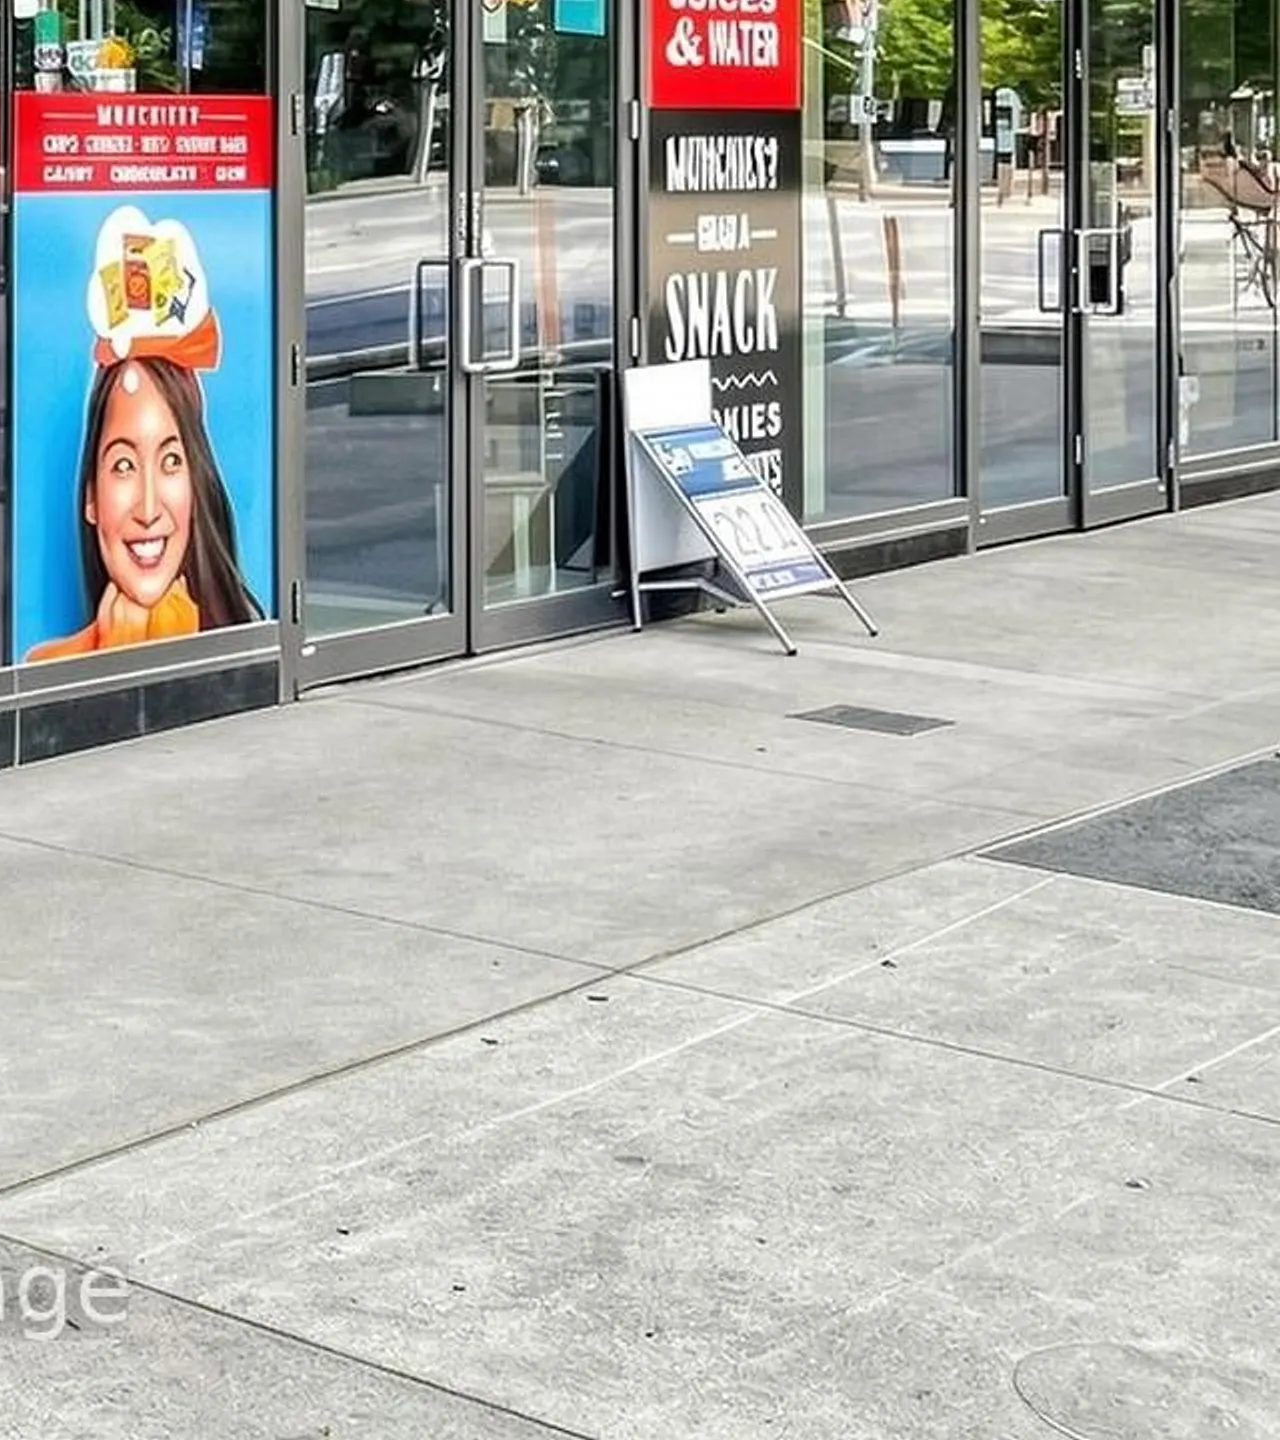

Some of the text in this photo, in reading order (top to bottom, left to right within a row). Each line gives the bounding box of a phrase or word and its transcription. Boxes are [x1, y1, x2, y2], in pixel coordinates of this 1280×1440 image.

[665, 16, 779, 67] & WATER
[665, 268, 779, 360] SNACK
